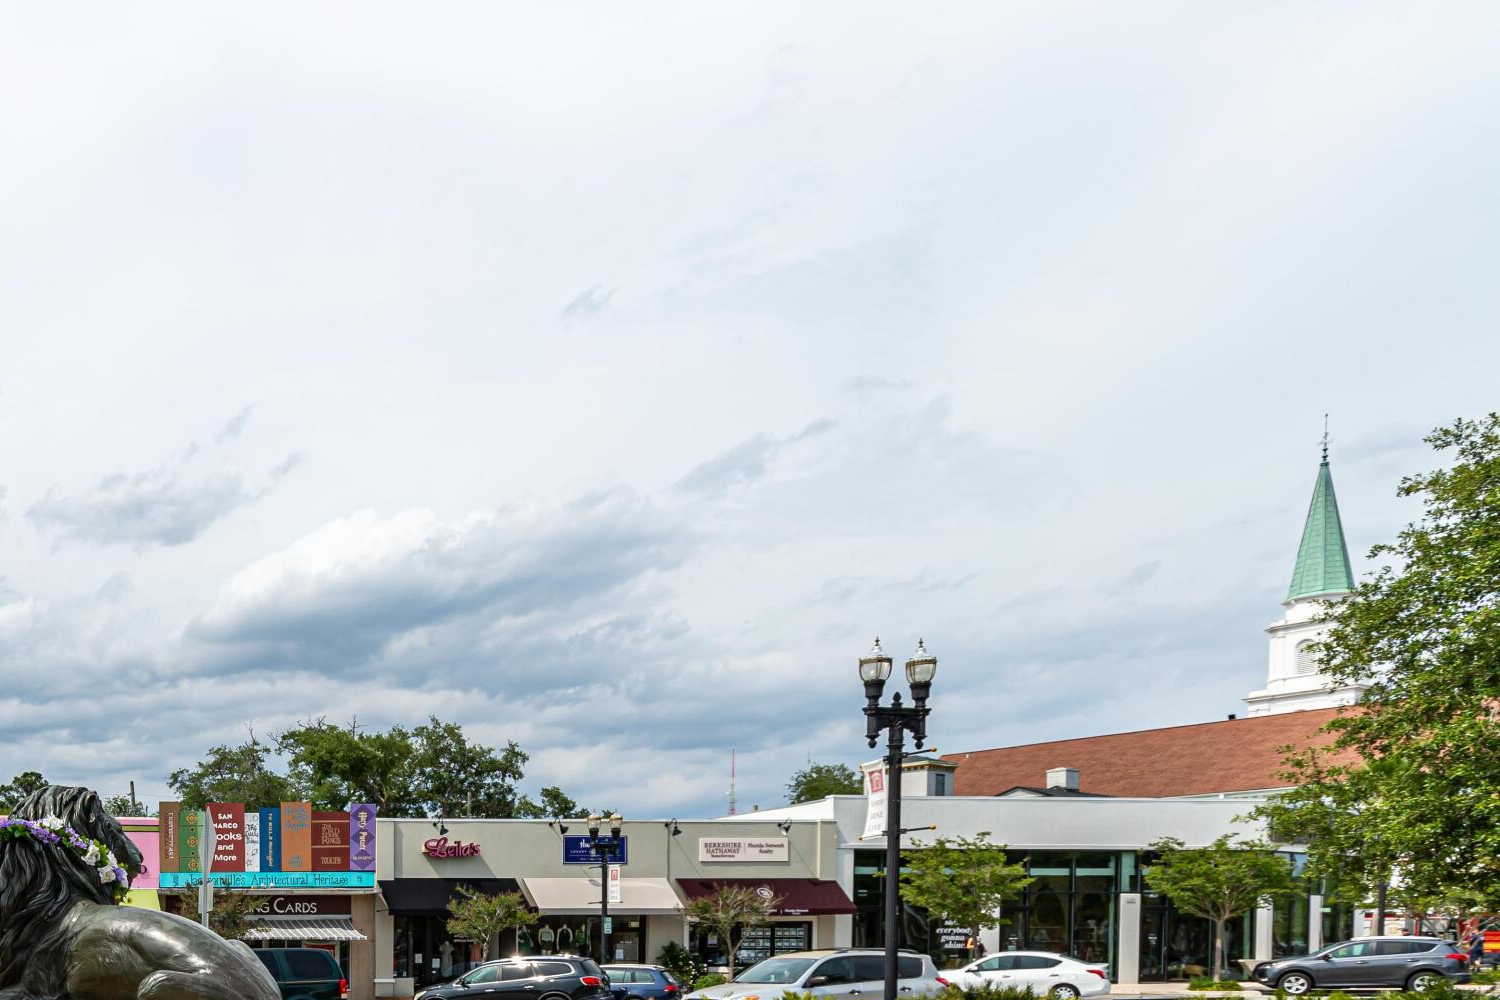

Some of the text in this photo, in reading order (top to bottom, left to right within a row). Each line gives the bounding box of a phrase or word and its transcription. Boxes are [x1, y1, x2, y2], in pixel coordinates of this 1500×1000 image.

[216, 832, 242, 840] ooks
[424, 837, 481, 857] Leila's
[251, 874, 309, 885] Architectural
[313, 874, 349, 886] Heritage
[273, 898, 317, 913] CARDS
